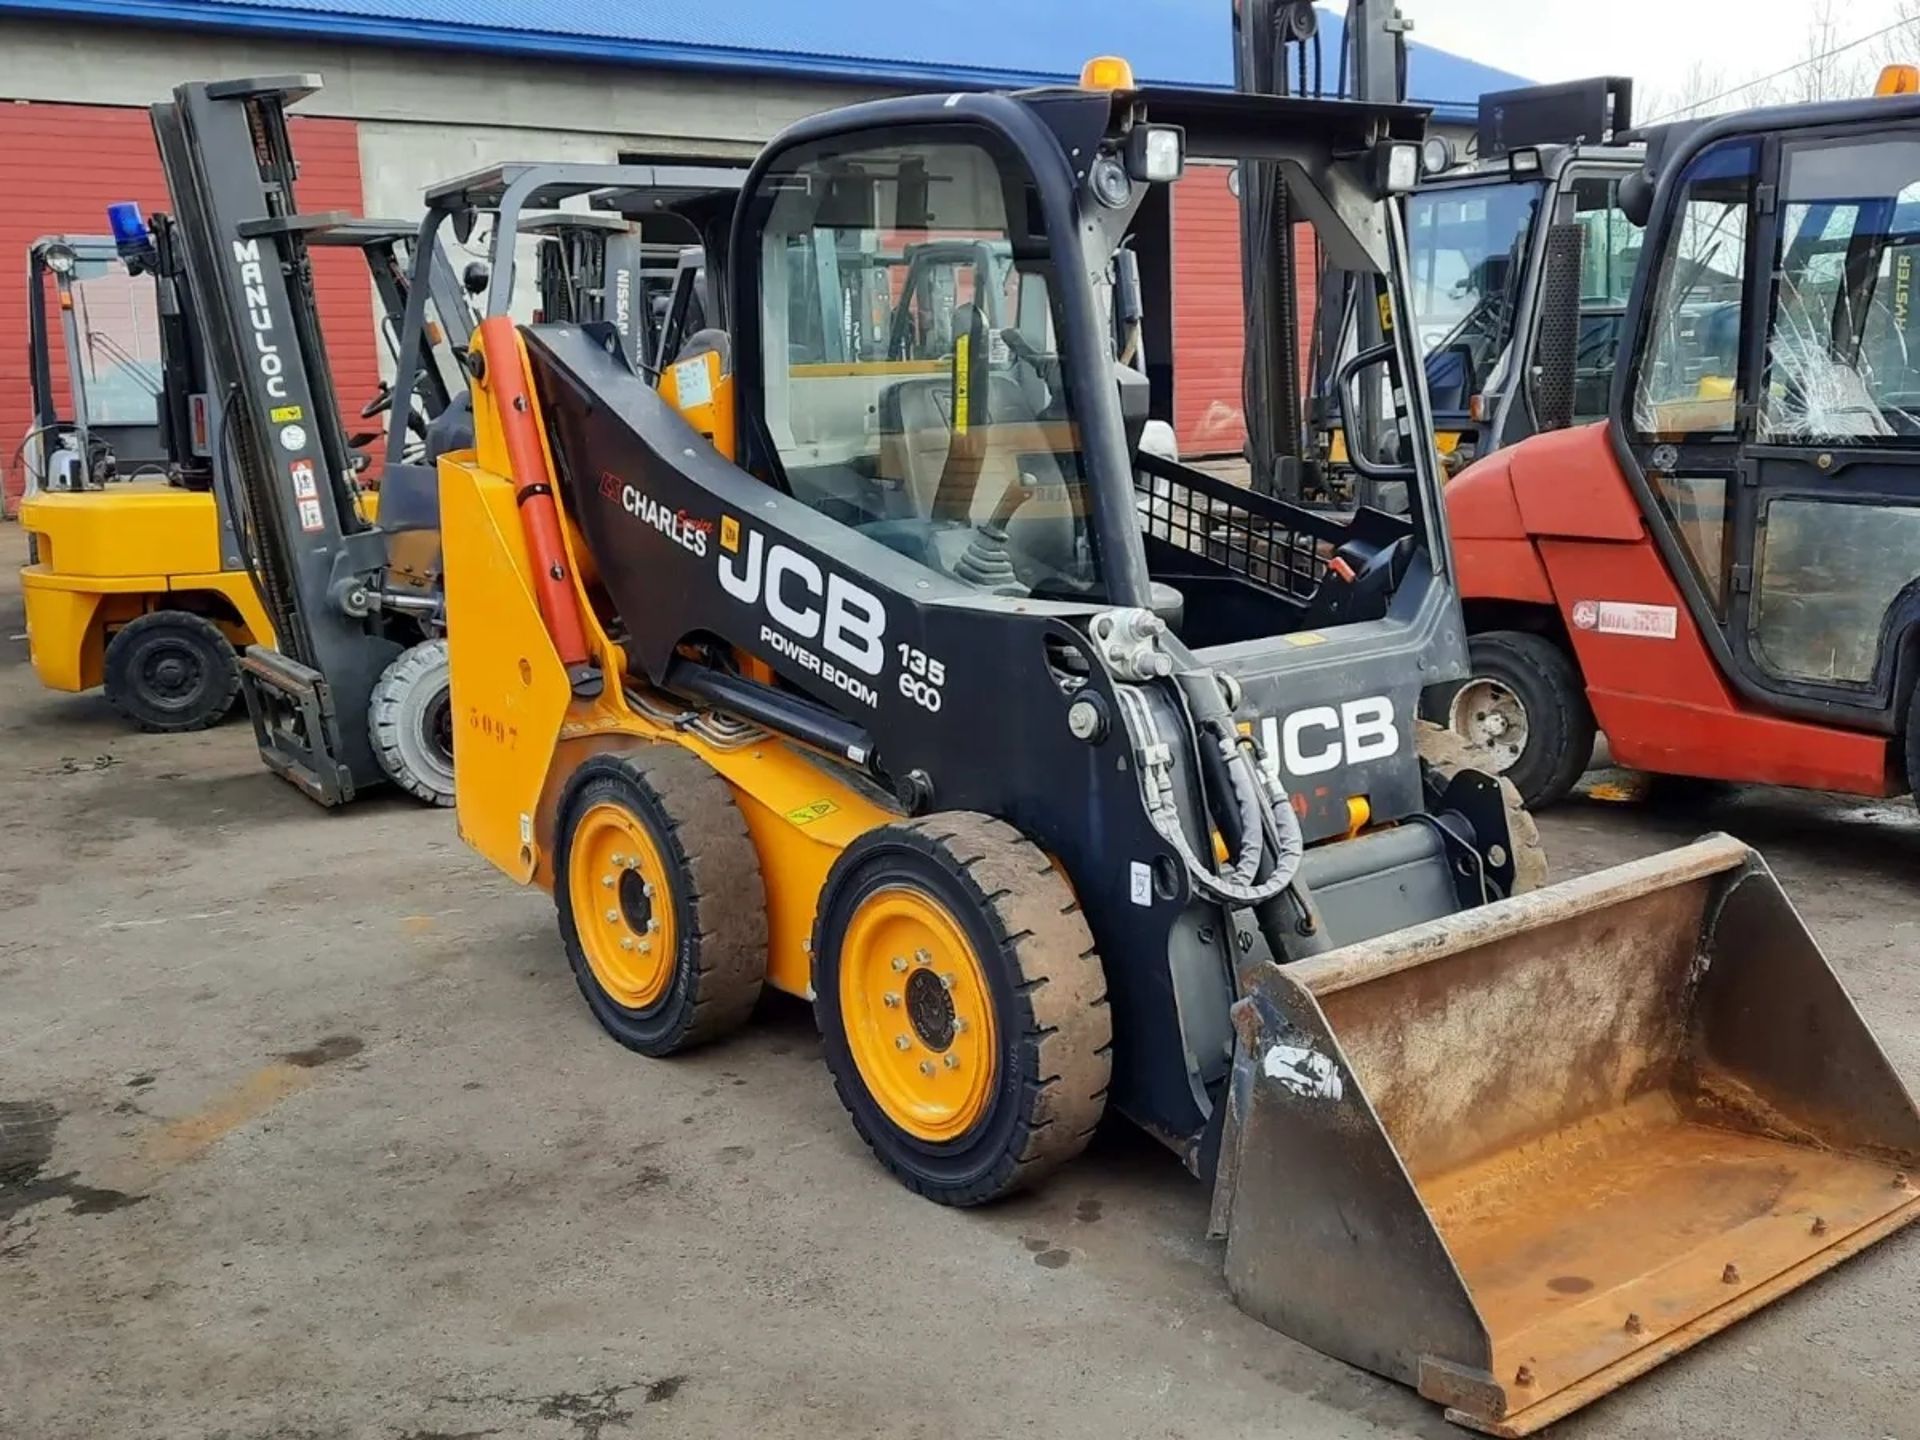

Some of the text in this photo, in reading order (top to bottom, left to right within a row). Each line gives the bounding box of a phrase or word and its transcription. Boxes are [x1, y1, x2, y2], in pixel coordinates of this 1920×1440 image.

[232, 239, 286, 397] MANULOC
[617, 269, 629, 336] NISSAN
[622, 485, 707, 557] CHARLES
[718, 529, 887, 676] JCB
[760, 625, 878, 709] POWER BOOM
[898, 643, 946, 687] 135
[899, 672, 942, 713] eco
